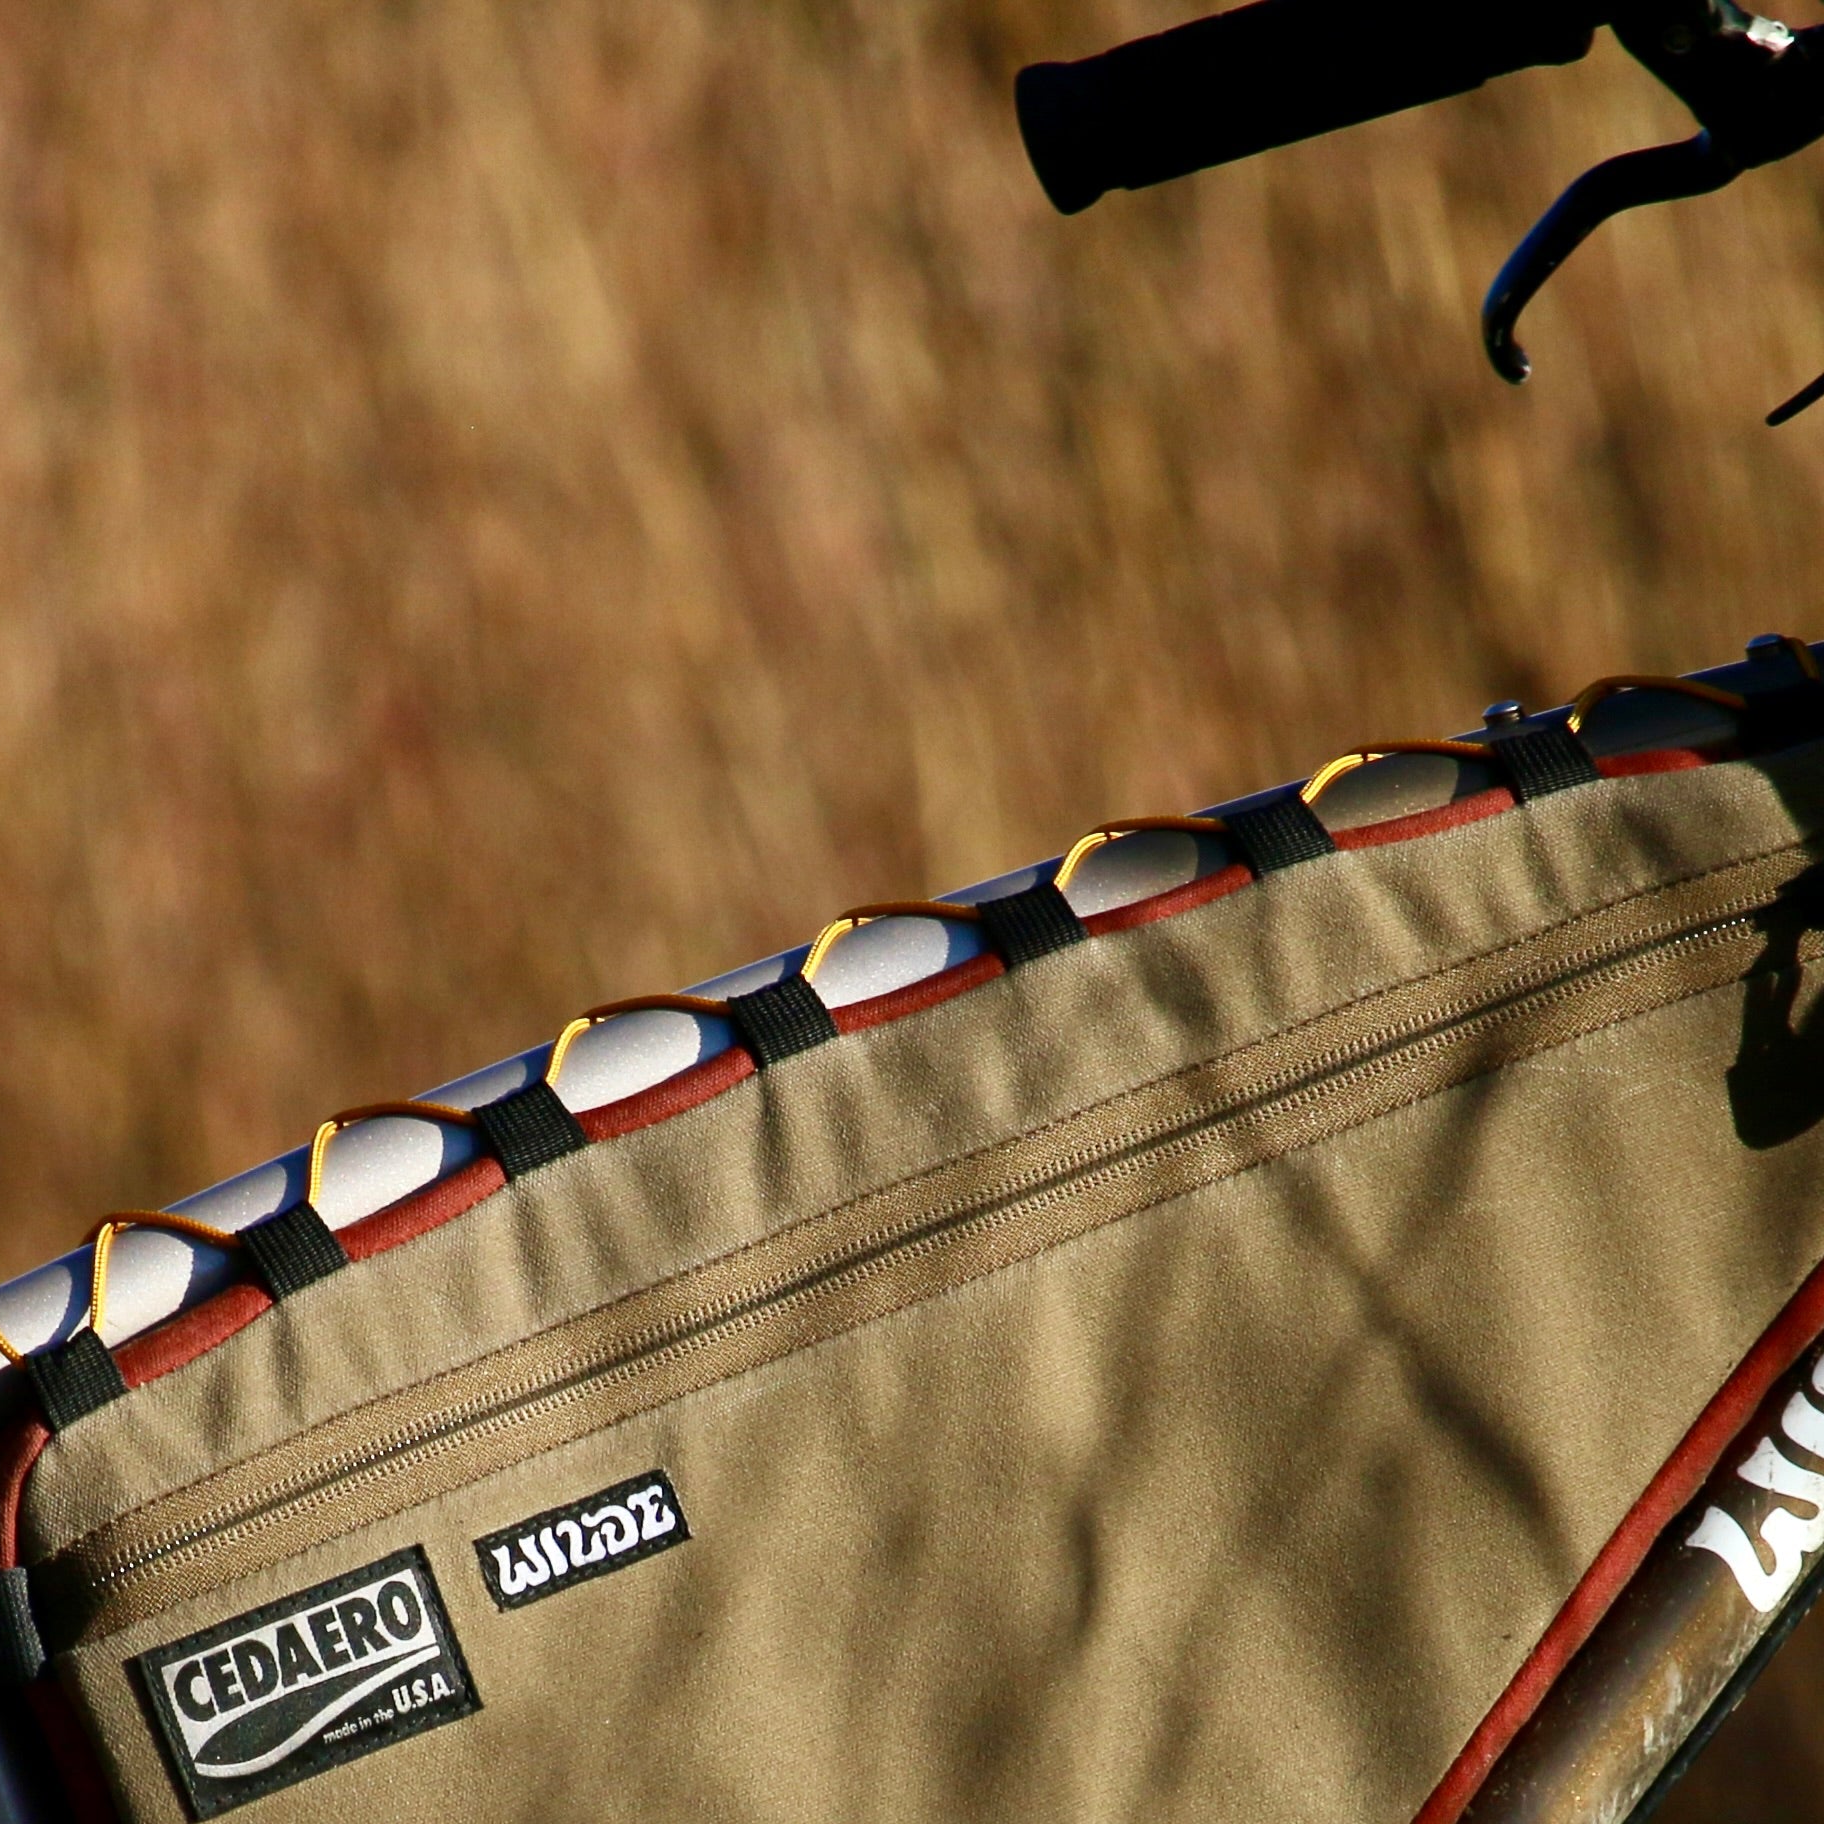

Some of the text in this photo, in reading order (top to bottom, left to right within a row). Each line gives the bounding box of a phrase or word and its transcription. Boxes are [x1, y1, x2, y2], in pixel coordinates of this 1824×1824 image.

[492, 1485, 676, 1596] WILDE
[173, 1580, 422, 1722] CEDAERO
[323, 1673, 456, 1744] made in the U.S.A.
